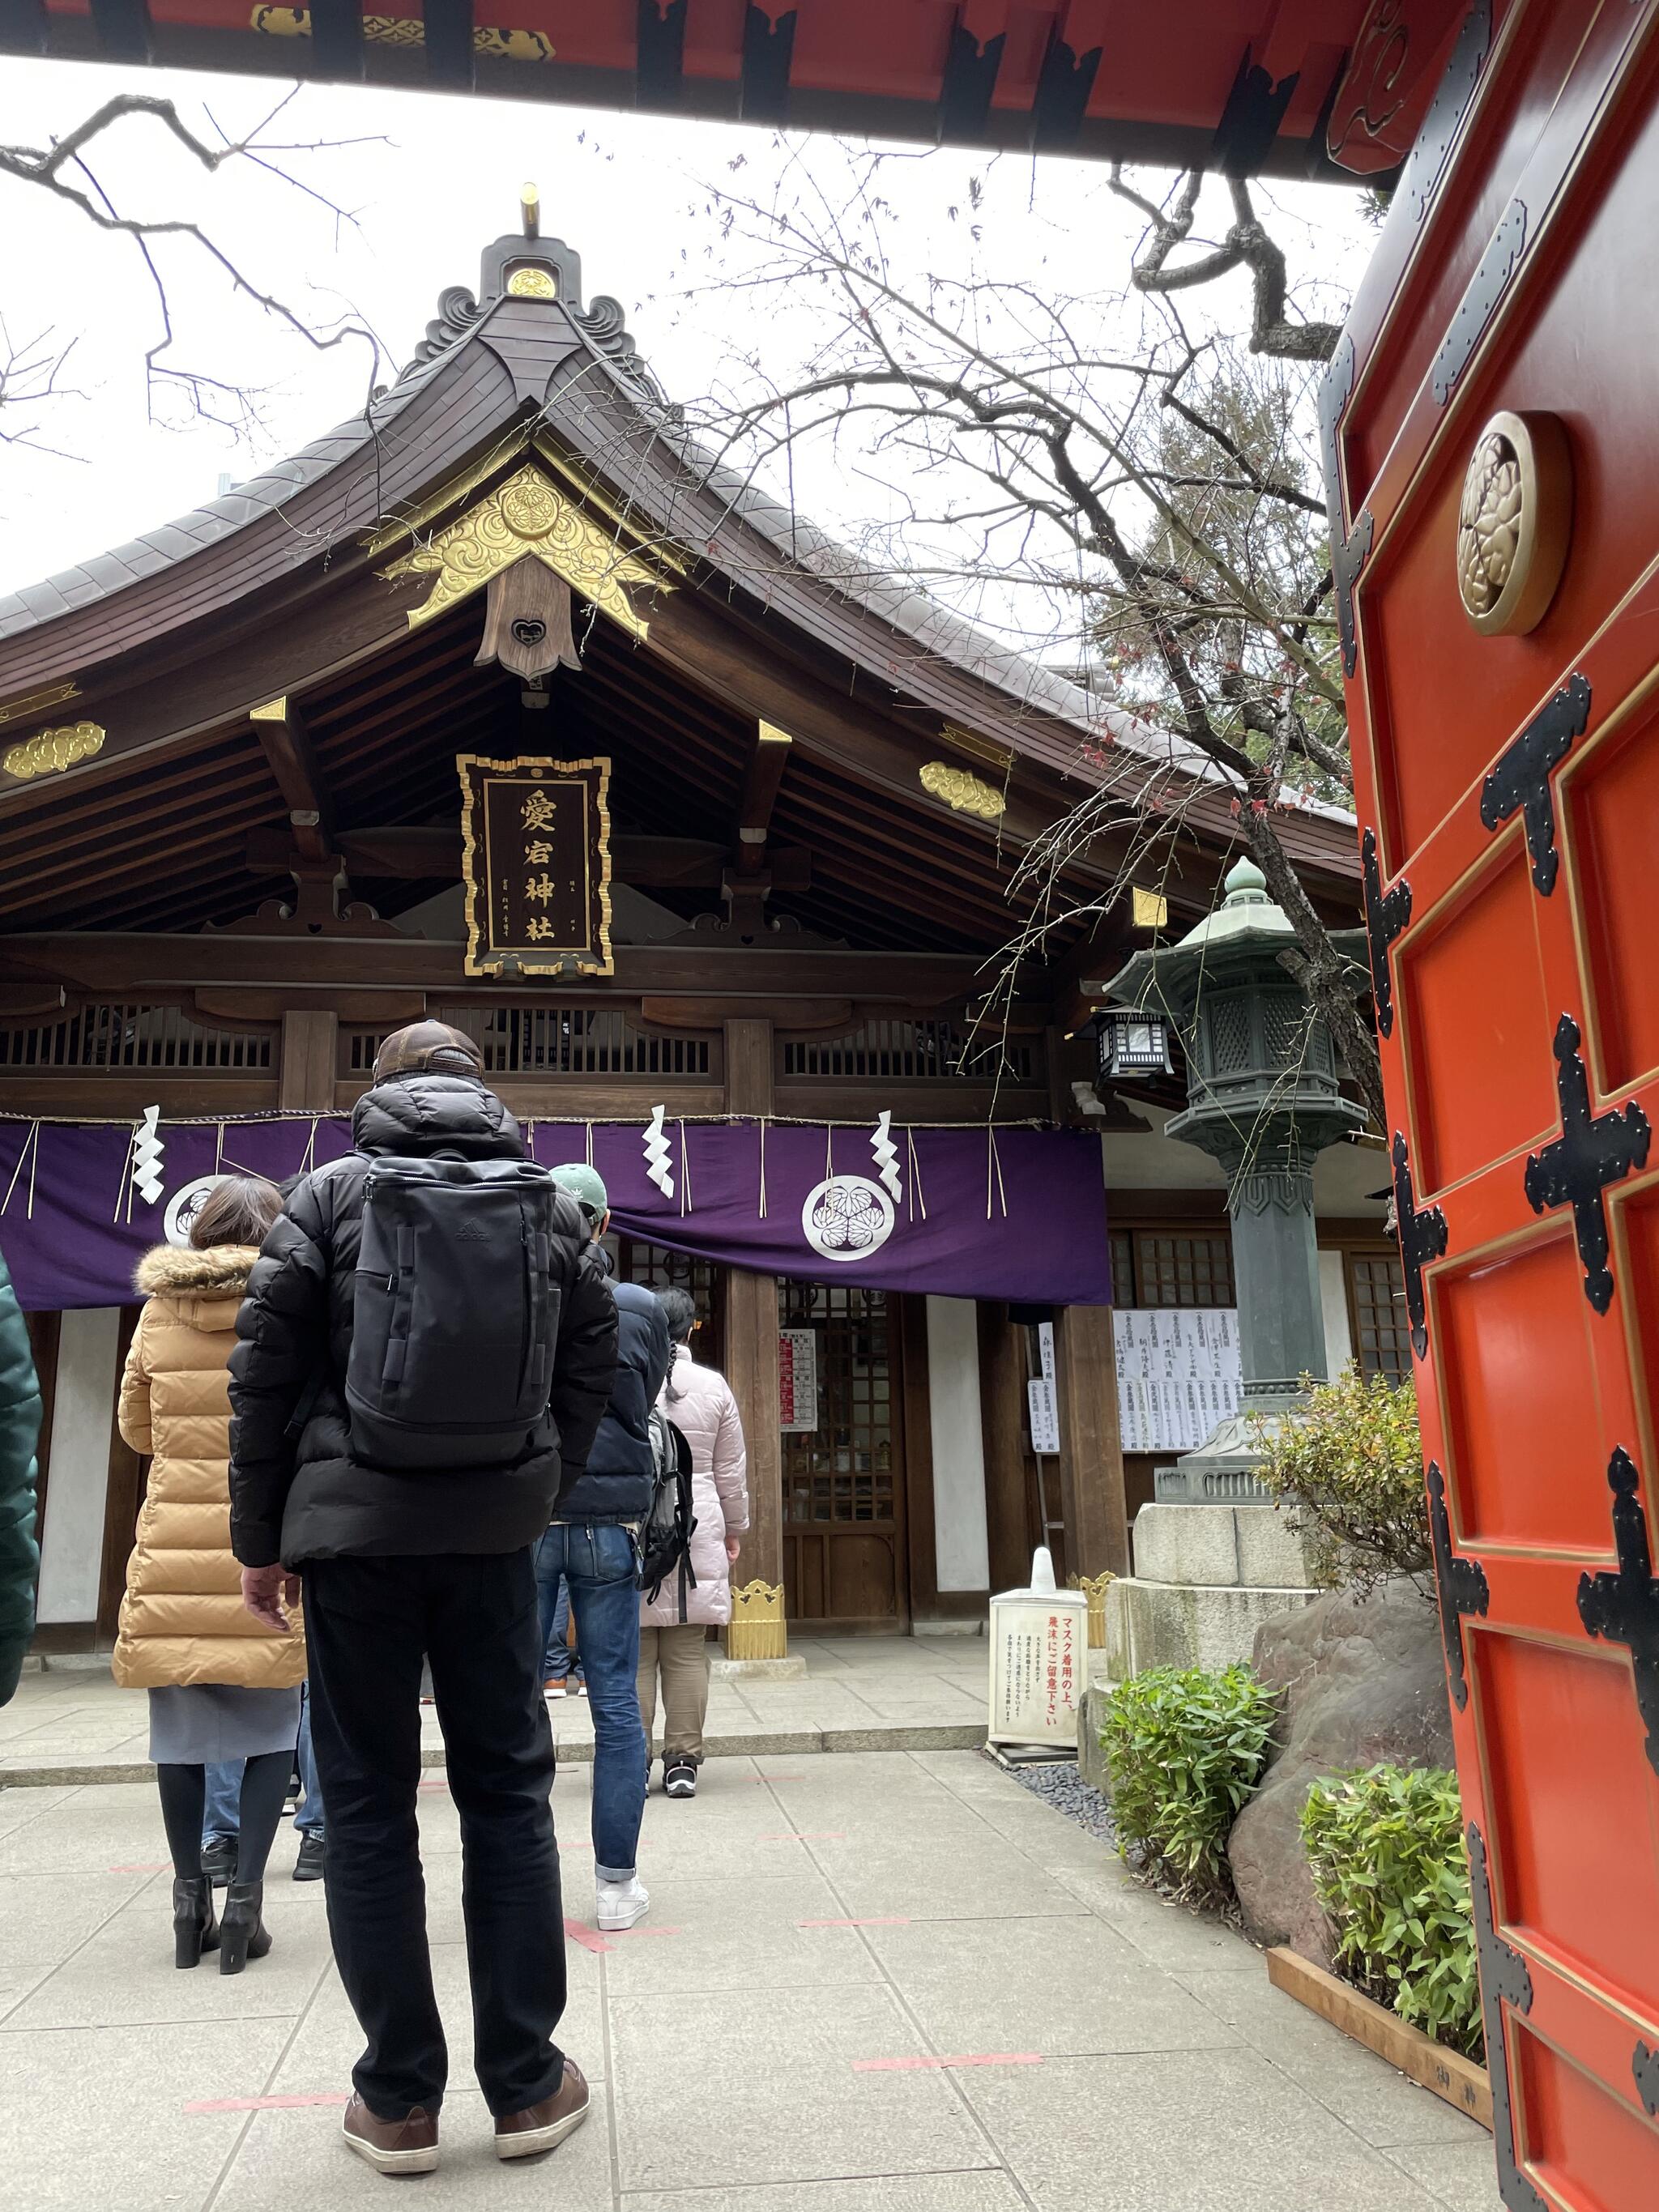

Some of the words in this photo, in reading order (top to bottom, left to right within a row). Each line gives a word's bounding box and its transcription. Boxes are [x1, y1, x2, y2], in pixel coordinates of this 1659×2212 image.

[519, 789, 558, 942] 愛宕神社
[1047, 1617, 1058, 1725] 飛沫にご留意下さい
[1061, 1618, 1073, 1711] マスク着用の上、
